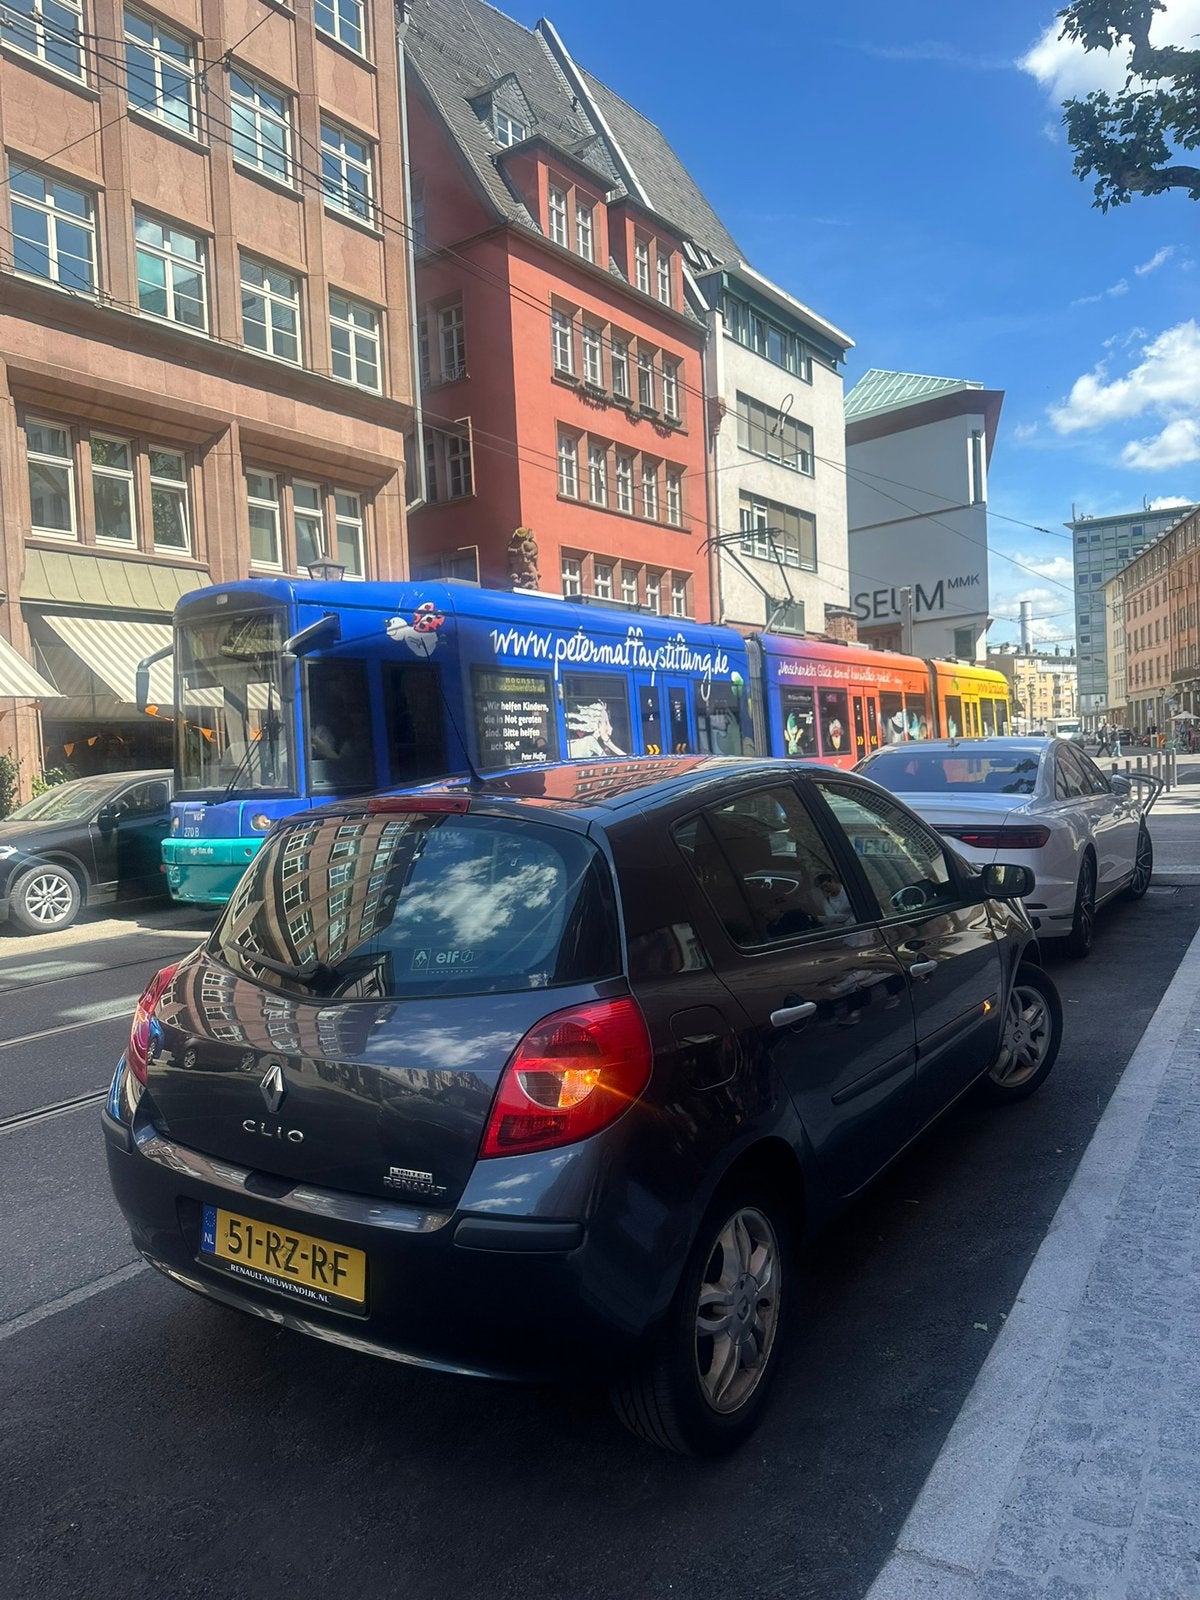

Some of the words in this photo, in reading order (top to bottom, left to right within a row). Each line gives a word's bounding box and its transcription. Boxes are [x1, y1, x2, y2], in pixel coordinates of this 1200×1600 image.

[947, 573, 980, 589] MMK
[489, 625, 730, 702] www.petermaffaystiftung.de
[501, 701, 522, 712] helfen
[523, 701, 550, 712] Kindern,
[484, 714, 495, 724] die
[496, 714, 504, 724] in
[504, 714, 518, 724] Not
[518, 715, 543, 727] geraten
[485, 728, 502, 738] sind.
[503, 728, 519, 738] Bitte
[520, 728, 541, 739] helfen
[436, 951, 460, 964] elf
[242, 1119, 305, 1144] CLIO
[391, 1167, 432, 1180] LIMITED
[383, 1176, 447, 1197] RENAULT
[204, 1232, 215, 1245] NL
[228, 1219, 349, 1286] 51-RZ-RF
[230, 1263, 330, 1304] RENAULT-NIEUWENDIJK.NL
